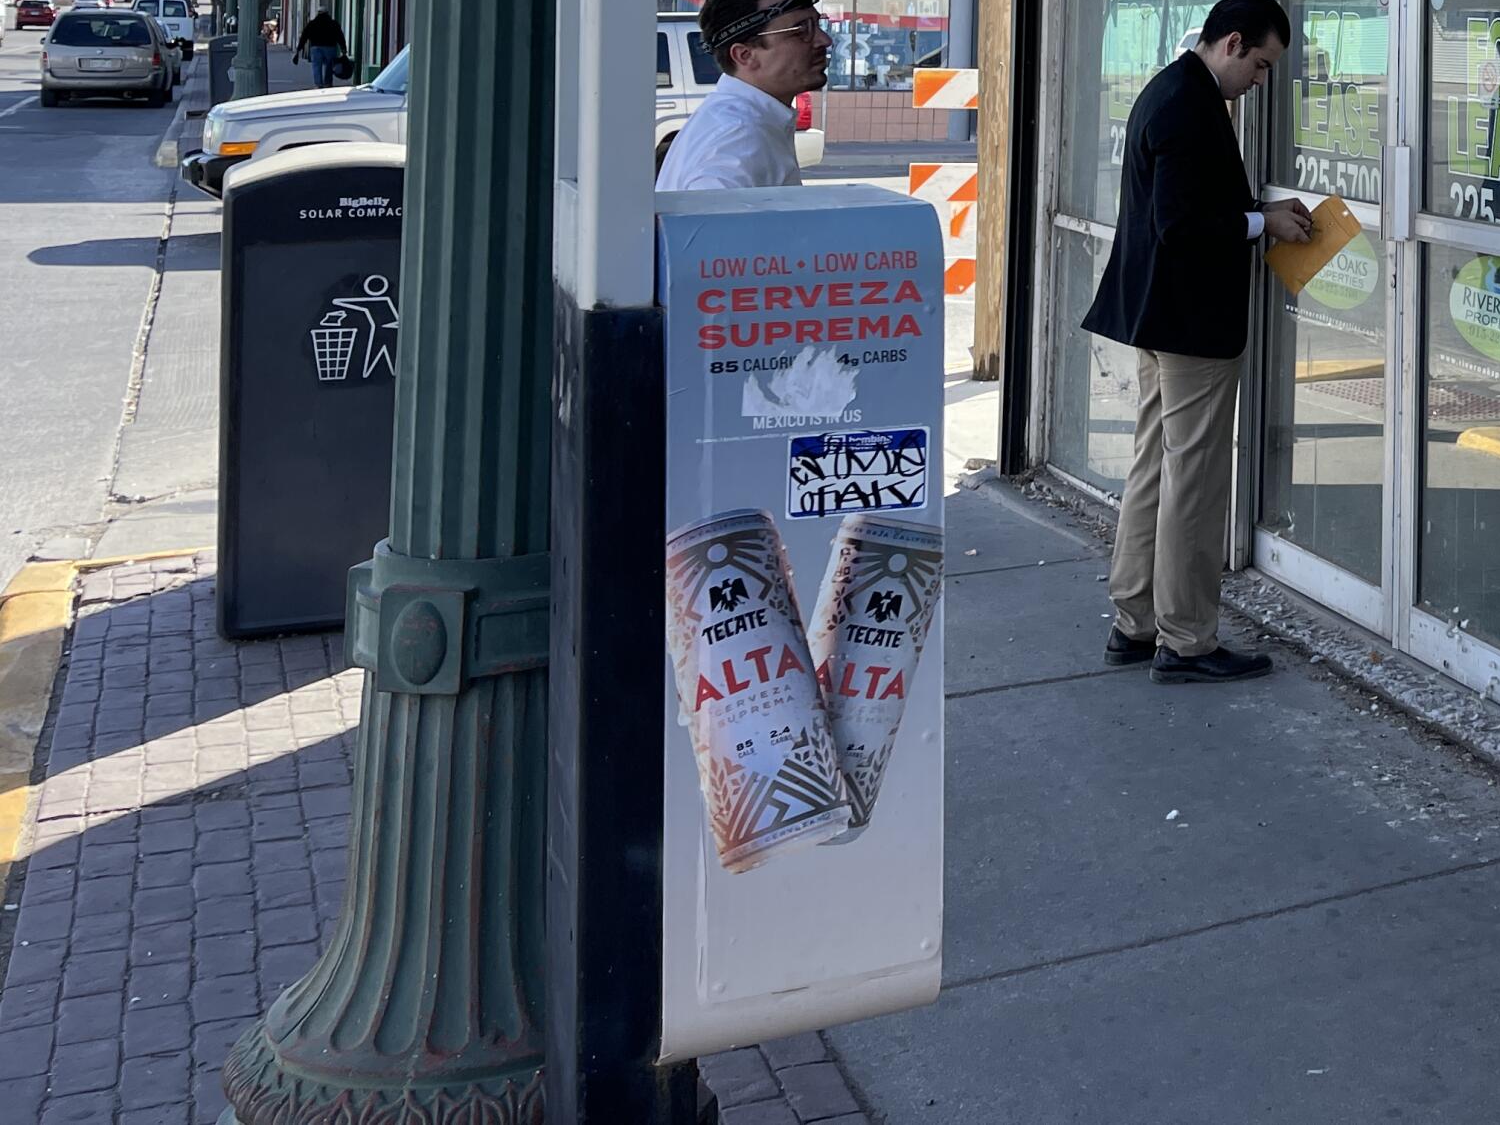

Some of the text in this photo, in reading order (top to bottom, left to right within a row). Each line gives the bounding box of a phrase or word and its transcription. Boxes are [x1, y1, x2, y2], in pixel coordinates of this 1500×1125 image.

[1308, 11, 1363, 84] FOR
[1293, 79, 1380, 159] LEASE
[299, 208, 342, 219] SOLAR
[339, 196, 390, 208] BigBelly
[701, 250, 918, 279] LOW CAL LOW CARB
[1337, 253, 1368, 277] OAKS
[697, 279, 923, 315] CERVEZA
[1463, 286, 1500, 315] RIVER
[697, 314, 922, 350] SUPREMA
[710, 360, 739, 374] 85
[863, 348, 908, 364] CARBS
[753, 415, 805, 430] MEXICO
[844, 409, 862, 423] US
[701, 608, 769, 645] TECATE
[846, 624, 905, 648] TECATE
[695, 643, 805, 713] ALTA
[815, 659, 905, 701] ALTA
[715, 684, 792, 716] CERVEZA
[718, 695, 795, 728] SUPREMA
[735, 739, 754, 752] 85
[769, 726, 791, 739] 2.4
